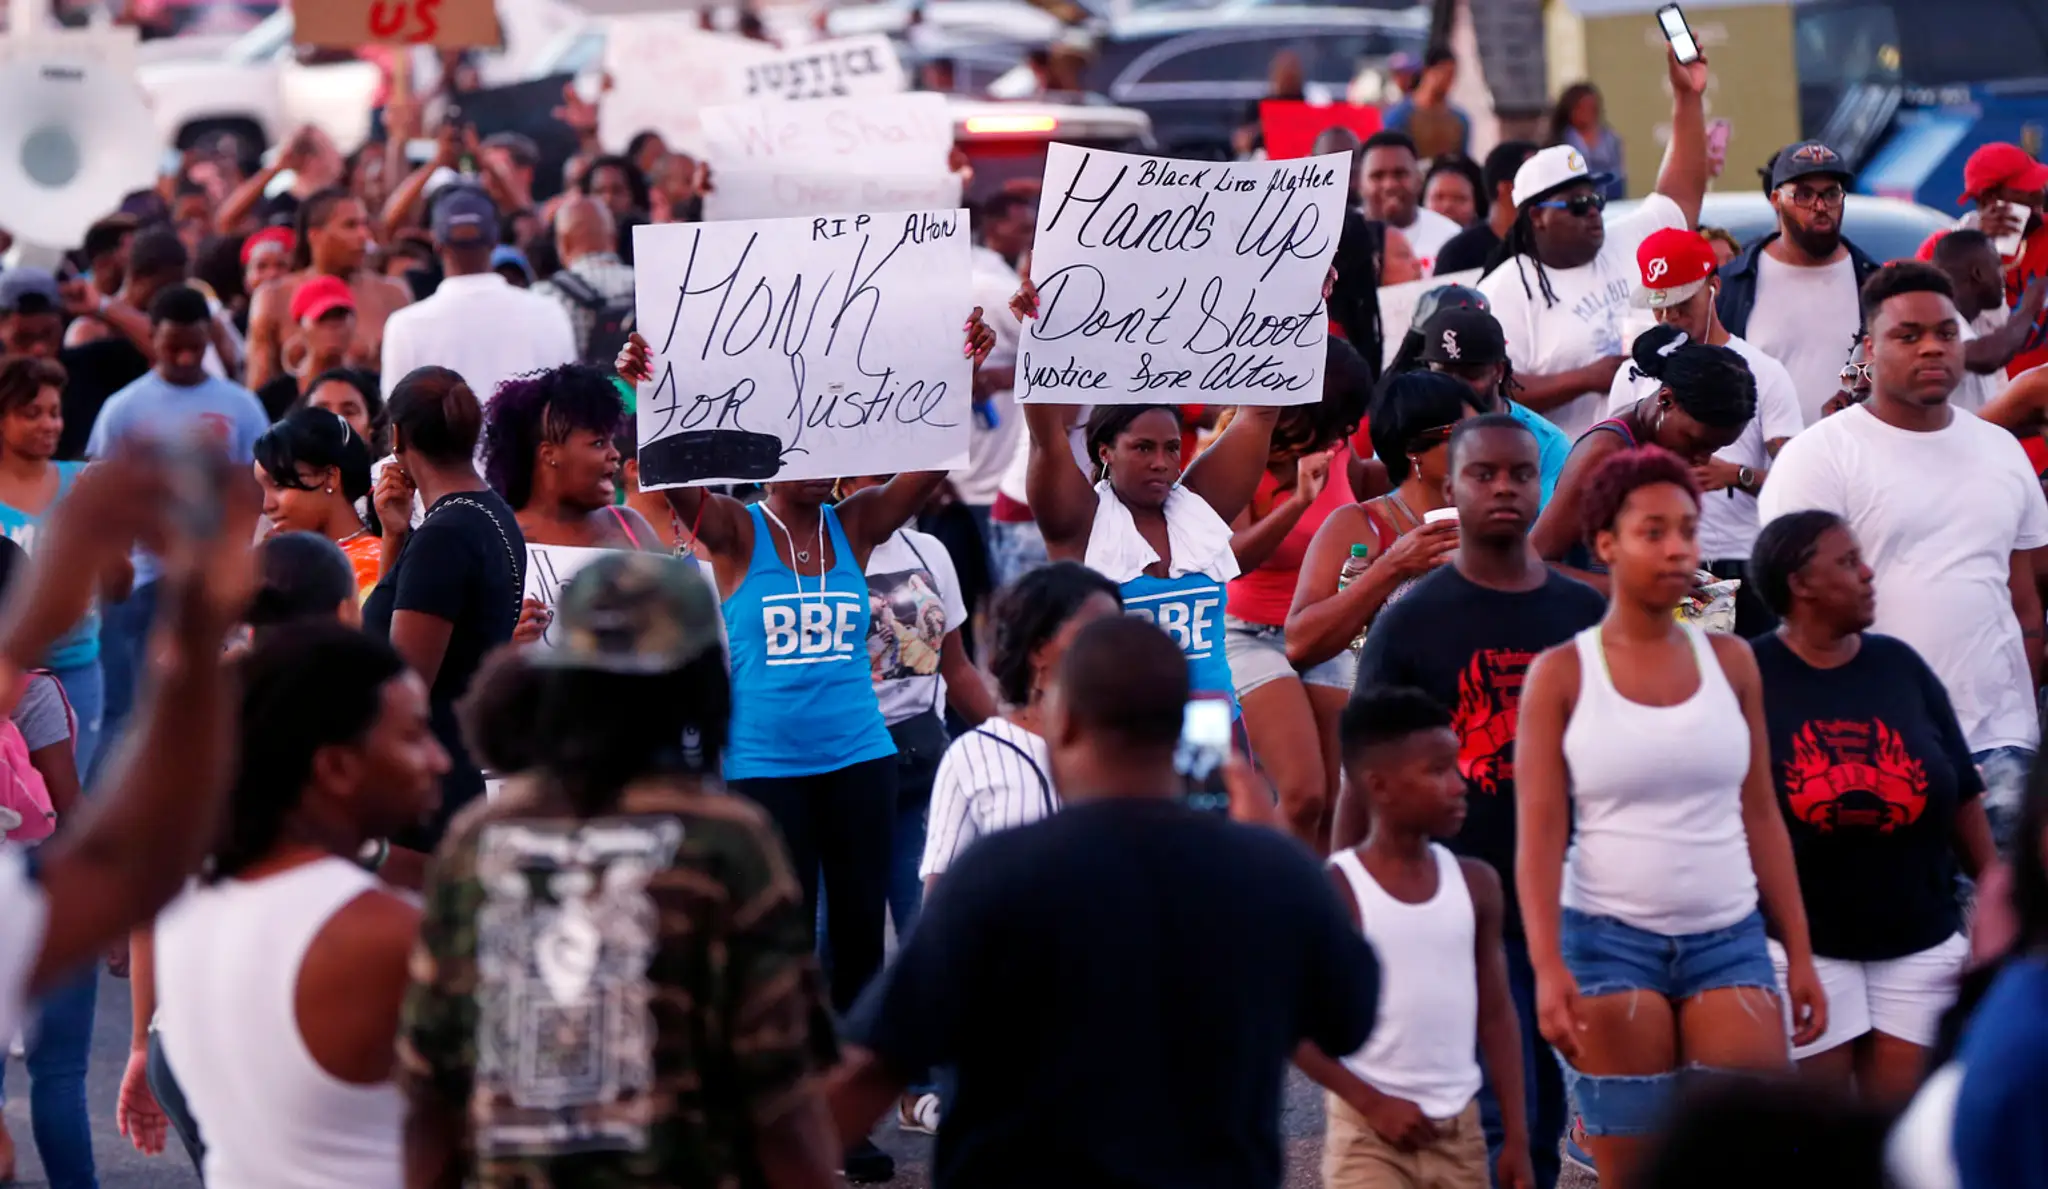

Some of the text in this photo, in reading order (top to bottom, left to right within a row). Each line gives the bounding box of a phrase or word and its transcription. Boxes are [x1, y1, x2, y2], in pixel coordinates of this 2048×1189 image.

[366, 0, 442, 42] US
[745, 46, 884, 94] JUSTICE
[1046, 152, 1216, 252] Hands
[1030, 264, 1324, 355] Don't Shoot
[1018, 351, 1113, 400] Justice
[762, 602, 861, 656] BBE
